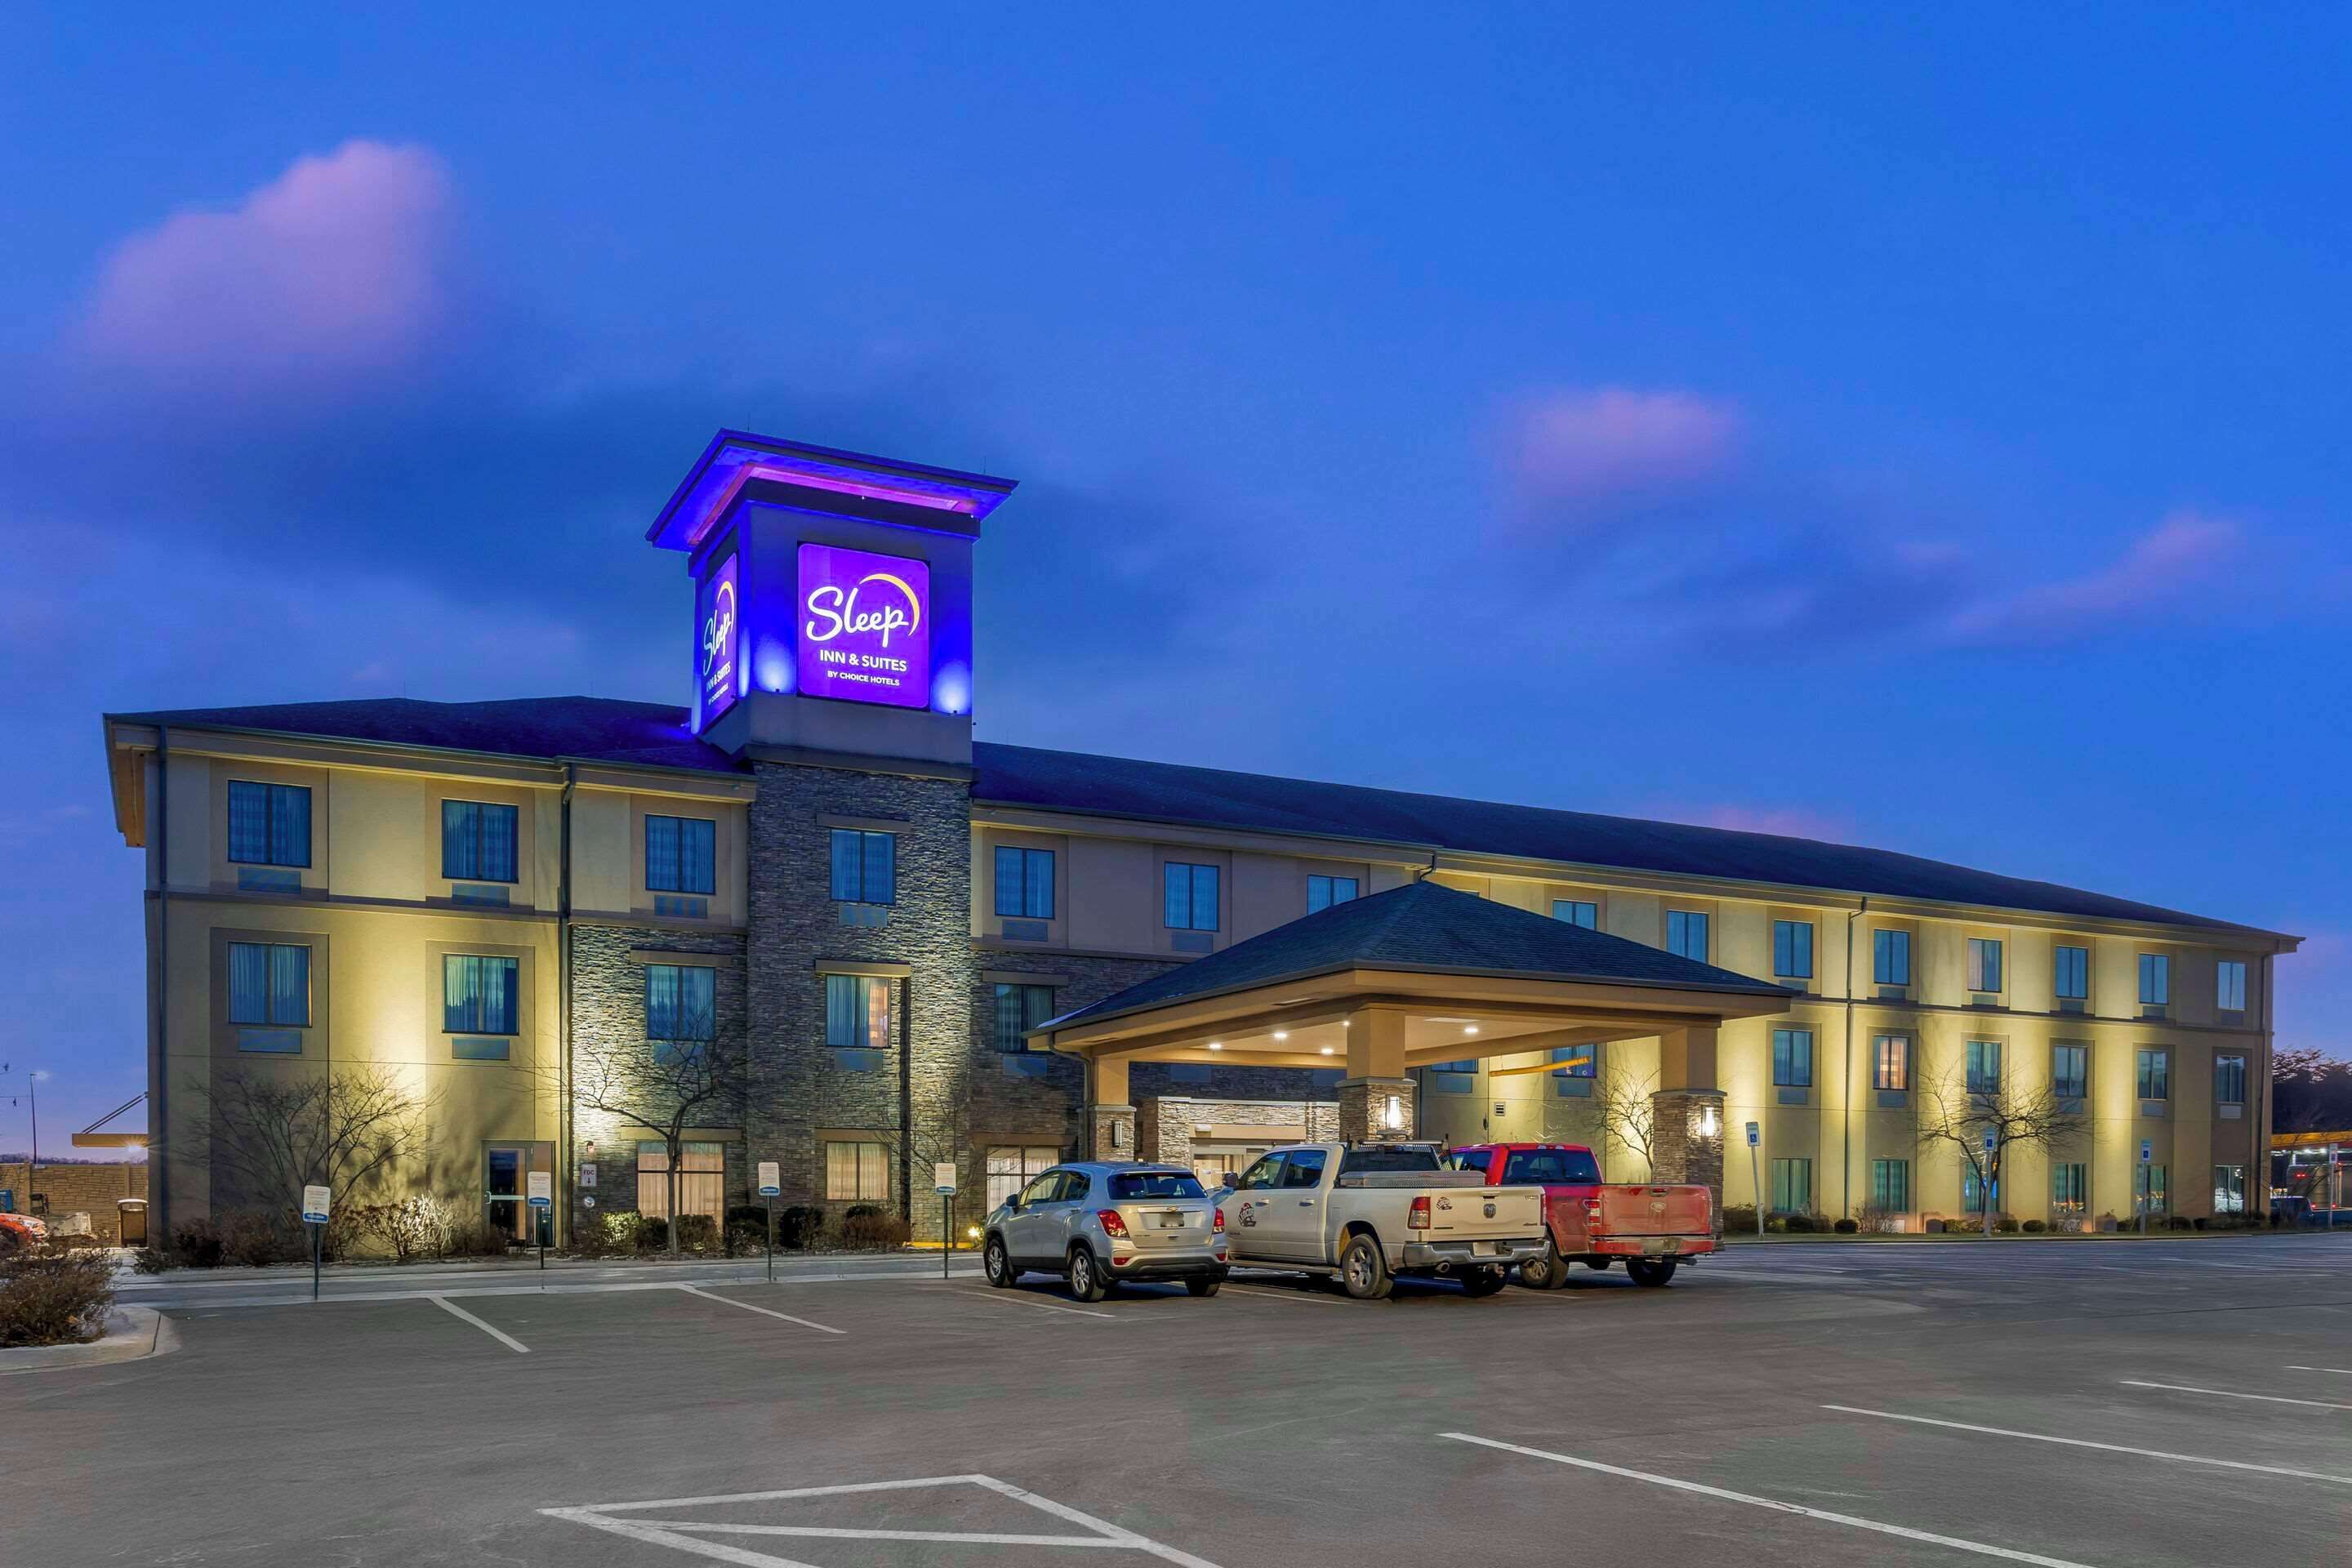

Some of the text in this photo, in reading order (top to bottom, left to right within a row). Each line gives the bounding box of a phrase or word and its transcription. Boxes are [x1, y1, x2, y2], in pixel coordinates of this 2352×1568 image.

[806, 586, 909, 648] Sleep
[703, 609, 732, 676] Sleep
[819, 649, 907, 672] INN & SUITES
[827, 670, 900, 686] BY CHOICE HOTELS
